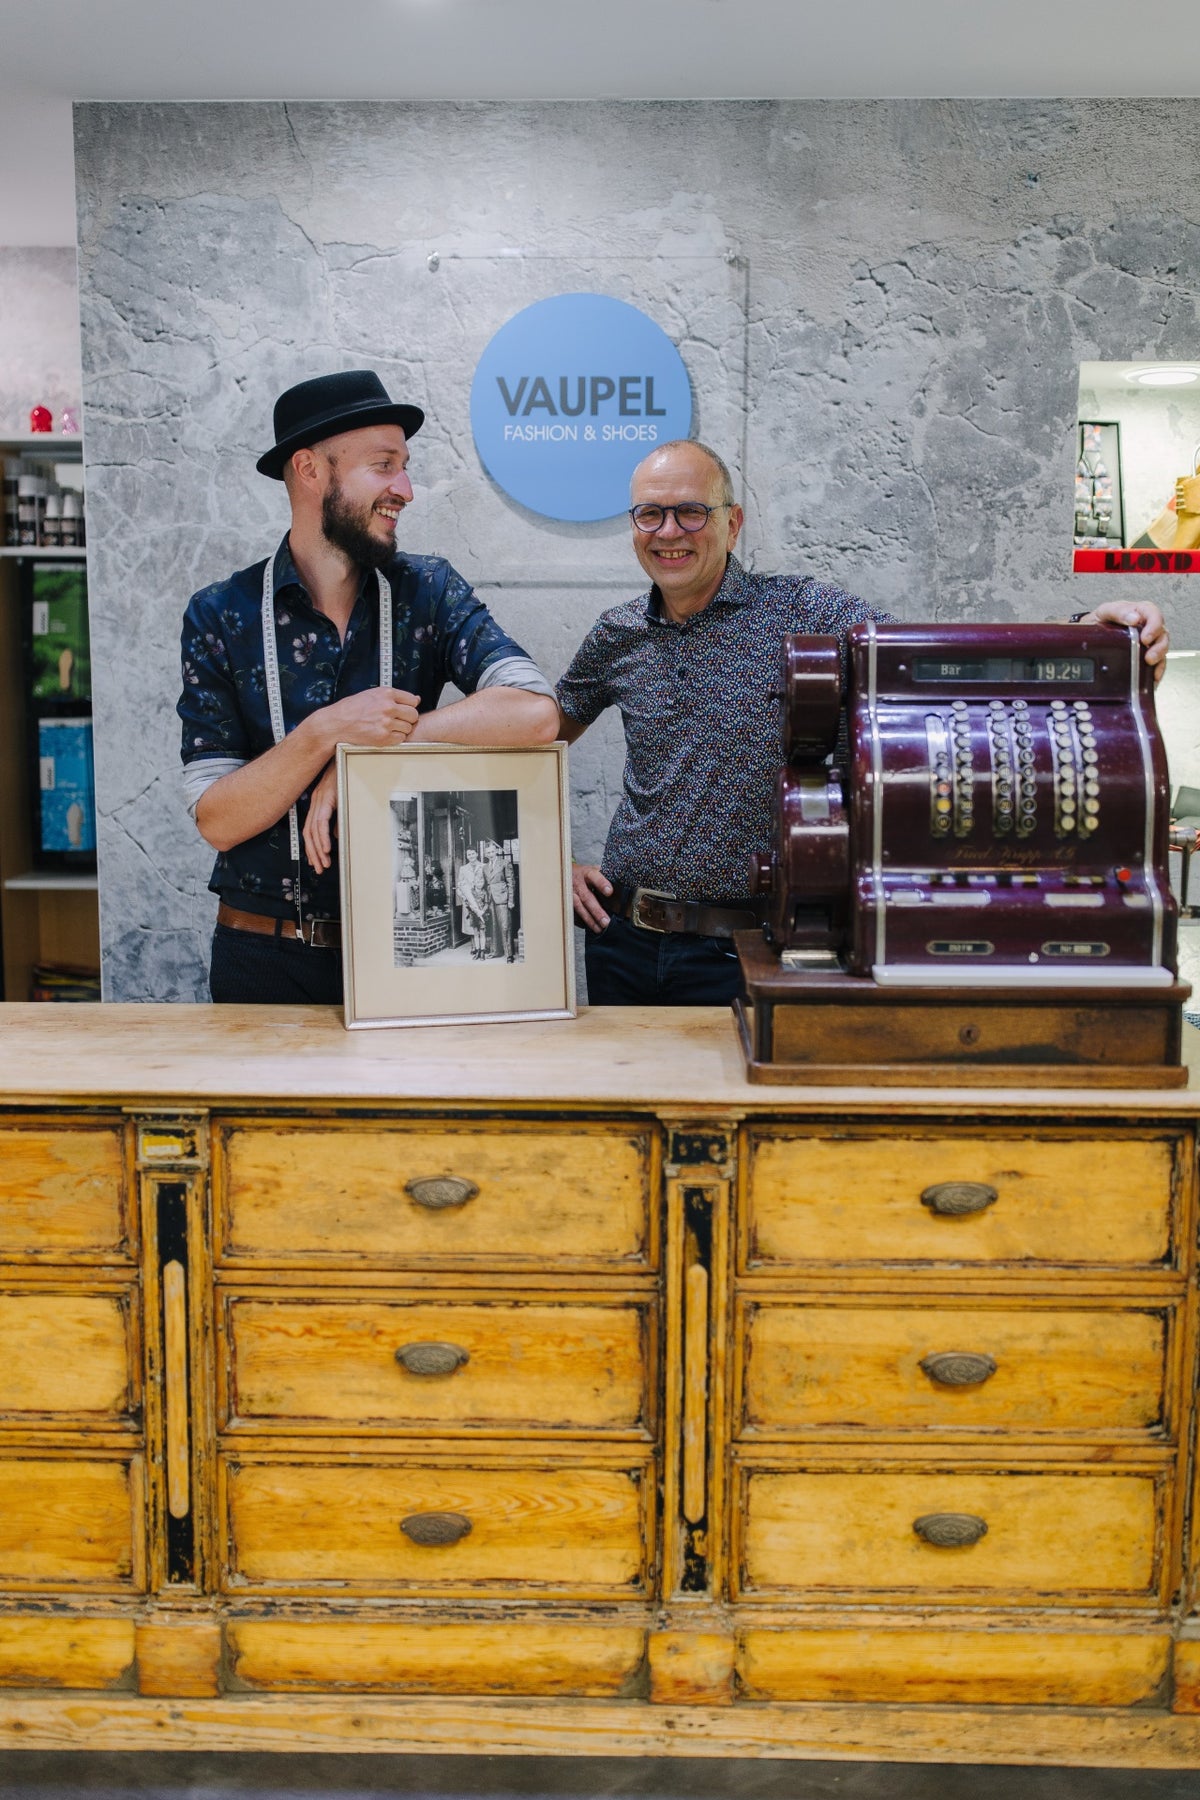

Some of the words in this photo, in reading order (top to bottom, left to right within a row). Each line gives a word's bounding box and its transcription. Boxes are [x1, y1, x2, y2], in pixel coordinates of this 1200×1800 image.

[496, 376, 667, 416] VAUPEL
[504, 424, 577, 441] FASHION
[584, 424, 597, 441] &
[602, 424, 658, 441] SHOES
[1104, 552, 1193, 571] LLOYD
[940, 664, 962, 676] Bar
[1036, 662, 1082, 680] 19.29
